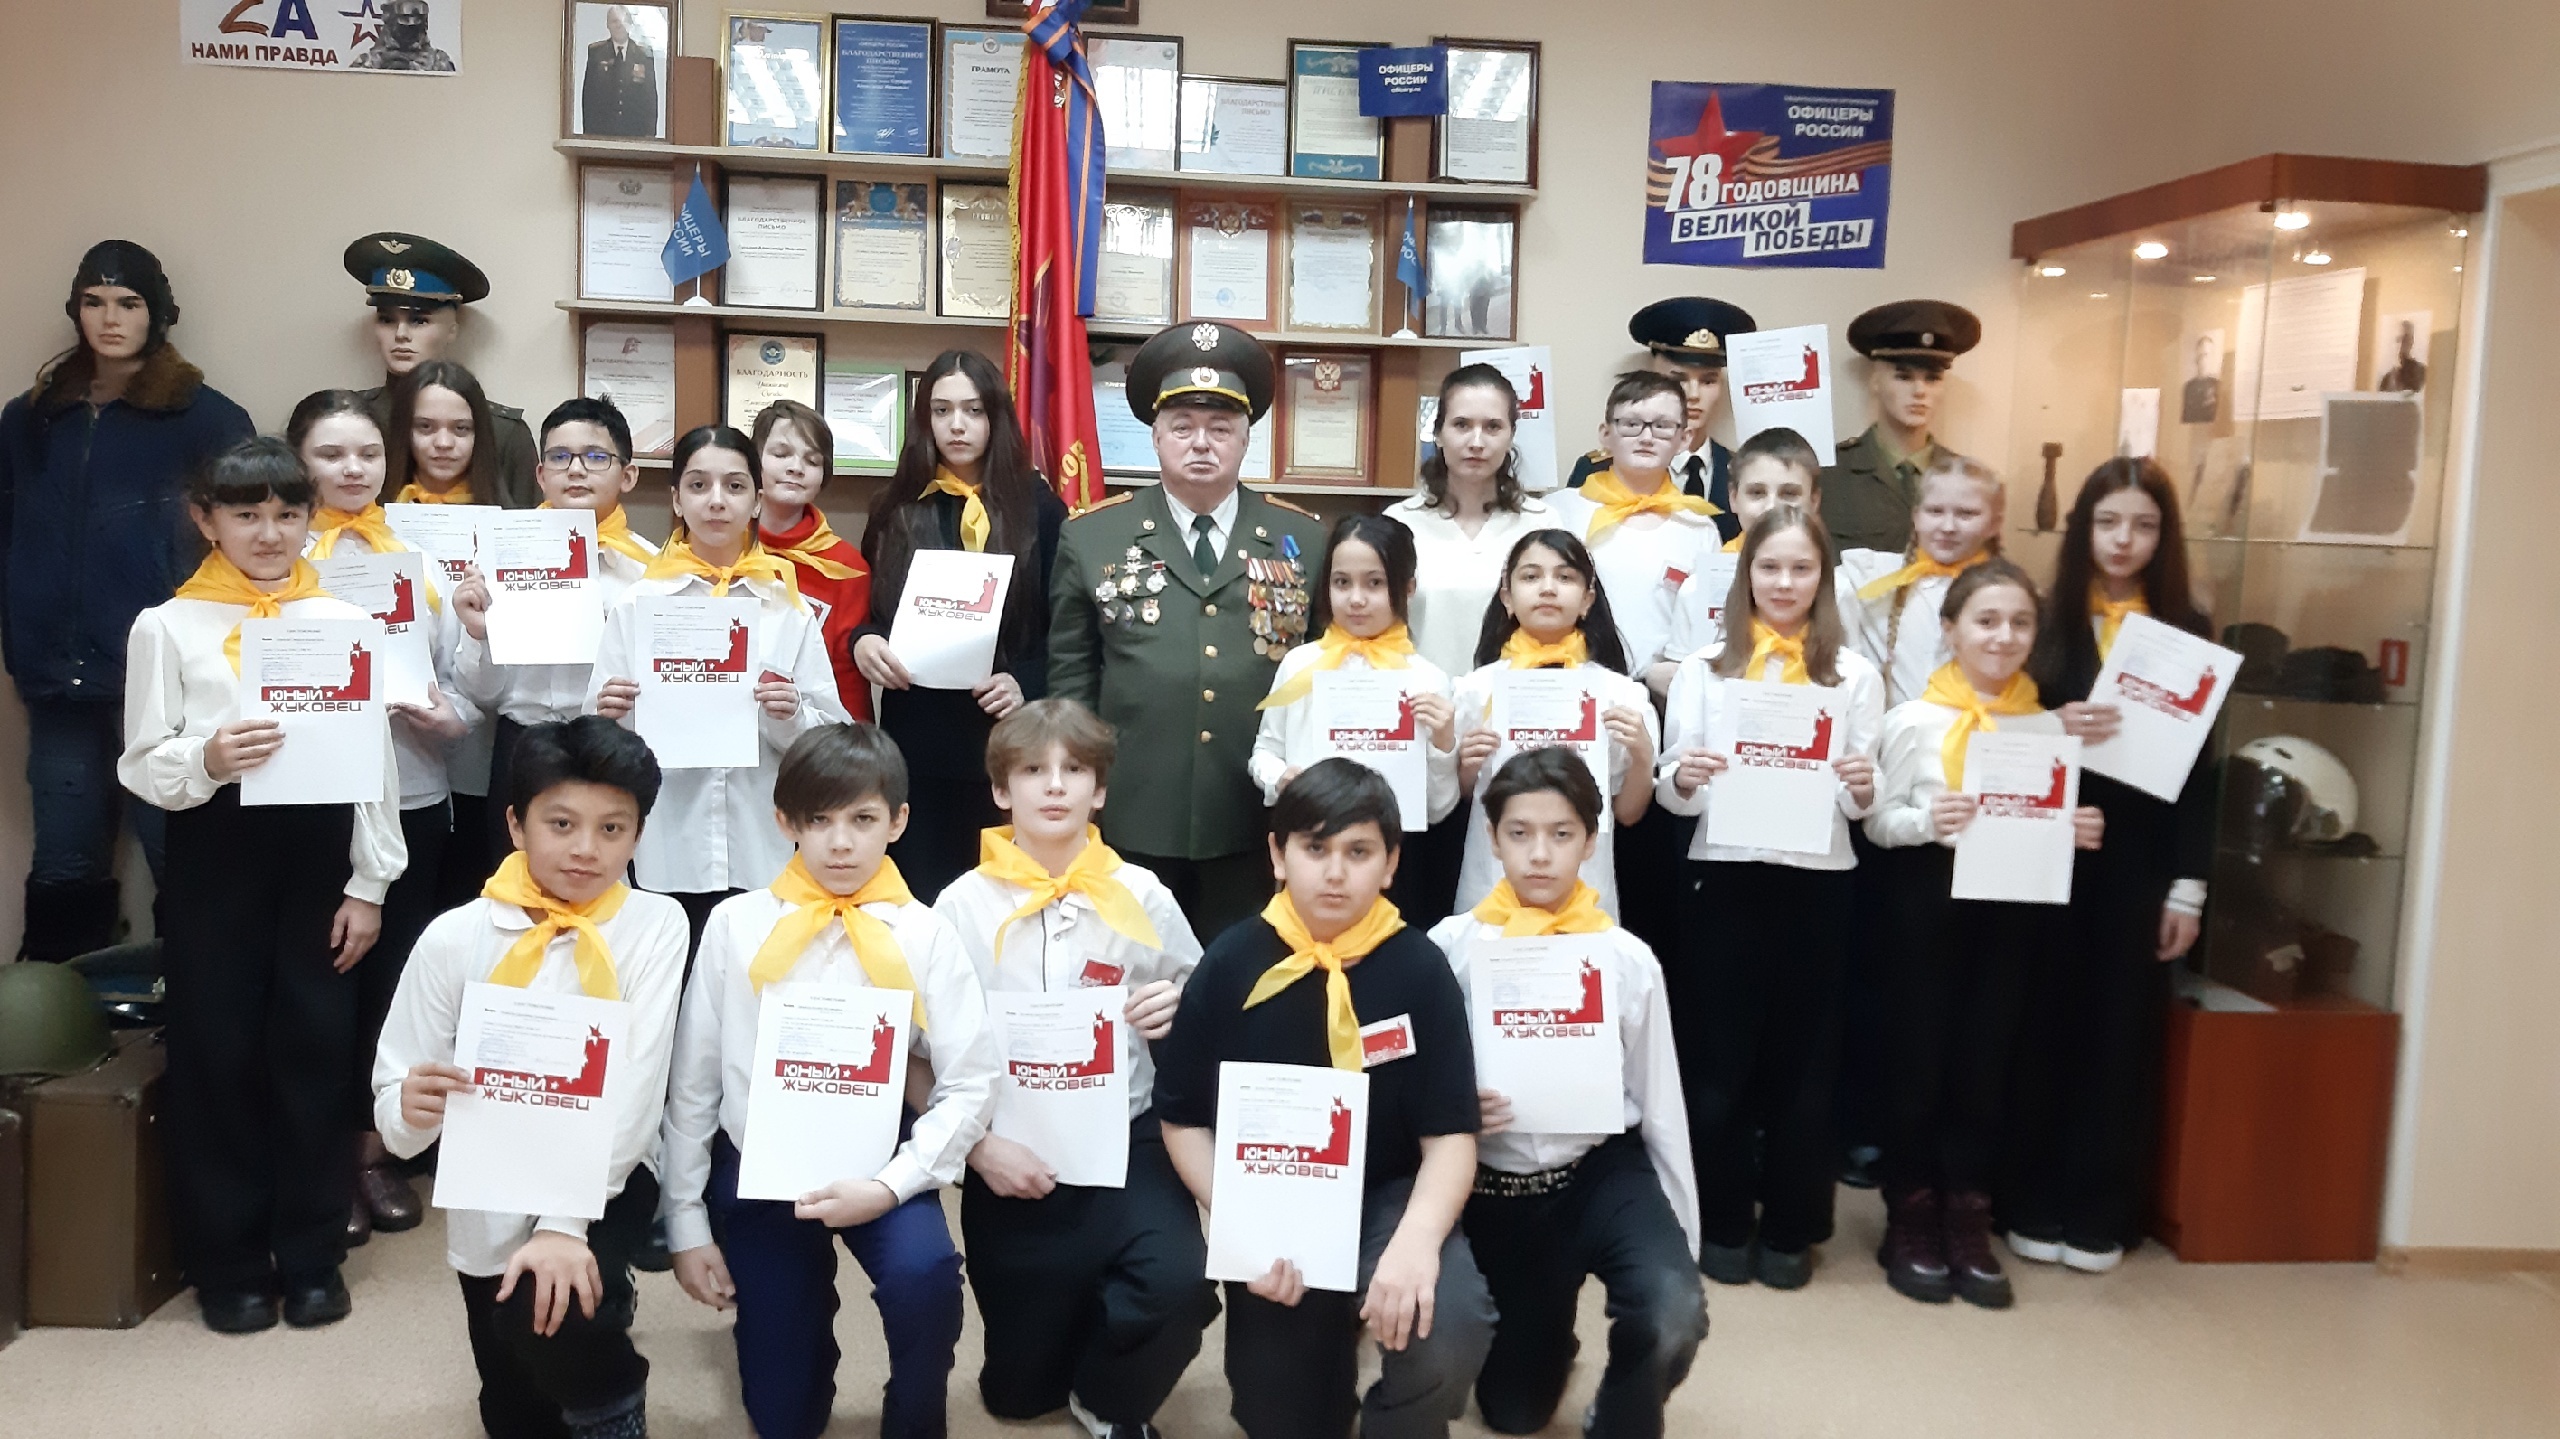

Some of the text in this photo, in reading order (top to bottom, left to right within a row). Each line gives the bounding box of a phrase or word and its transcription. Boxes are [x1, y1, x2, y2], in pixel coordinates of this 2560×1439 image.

[192, 43, 339, 66] НАМИ ПРАВДА
[971, 66, 1011, 74] ГРАМОТА
[1378, 64, 1433, 75] ОФИЦЕРЫ
[1384, 76, 1428, 86] РОССИИ
[1788, 105, 1874, 121] ОФИЦЕРЫ
[1795, 123, 1864, 137] РОССИИ
[1664, 153, 1860, 213] 78 ГОДОВЩИНА
[1678, 203, 1801, 238] ВЕЛИКОЙ
[1754, 223, 1864, 251] ПОБЕДЫ
[736, 369, 808, 378] БЛАГОДАРНОСТЬ
[503, 569, 549, 581] ЮНЫЙ
[505, 581, 581, 591] ЖУКОВЕЦ
[918, 608, 982, 621] ЖУКОВЕЦ
[660, 660, 706, 672] ЮНЫЙ
[661, 673, 740, 683] ЖУКОВЕЦ
[269, 688, 323, 701] ЮНЫЙ
[270, 702, 362, 713] ЖУКОВЕЦ
[1741, 744, 1787, 757] ЮНЫЙ
[1741, 757, 1819, 771] ЖУКОВЕЦ
[1501, 1011, 1555, 1025] ЮНЫЙ
[1502, 1025, 1596, 1039] ЖУКОВЕЦ
[783, 1064, 840, 1080] ЮНЫЙ
[1016, 1064, 1067, 1078] ЮНЫЙ
[483, 1073, 547, 1092] ЮНЫЙ
[782, 1079, 879, 1096] ЖУКОВЕЦ
[1017, 1077, 1106, 1091] ЖУКОВЕЦ
[482, 1087, 590, 1111] ЖУКОВЕЦ
[1243, 1147, 1299, 1162] ЮНЫЙ
[1243, 1162, 1338, 1180] ЖУКОВЕЦ
